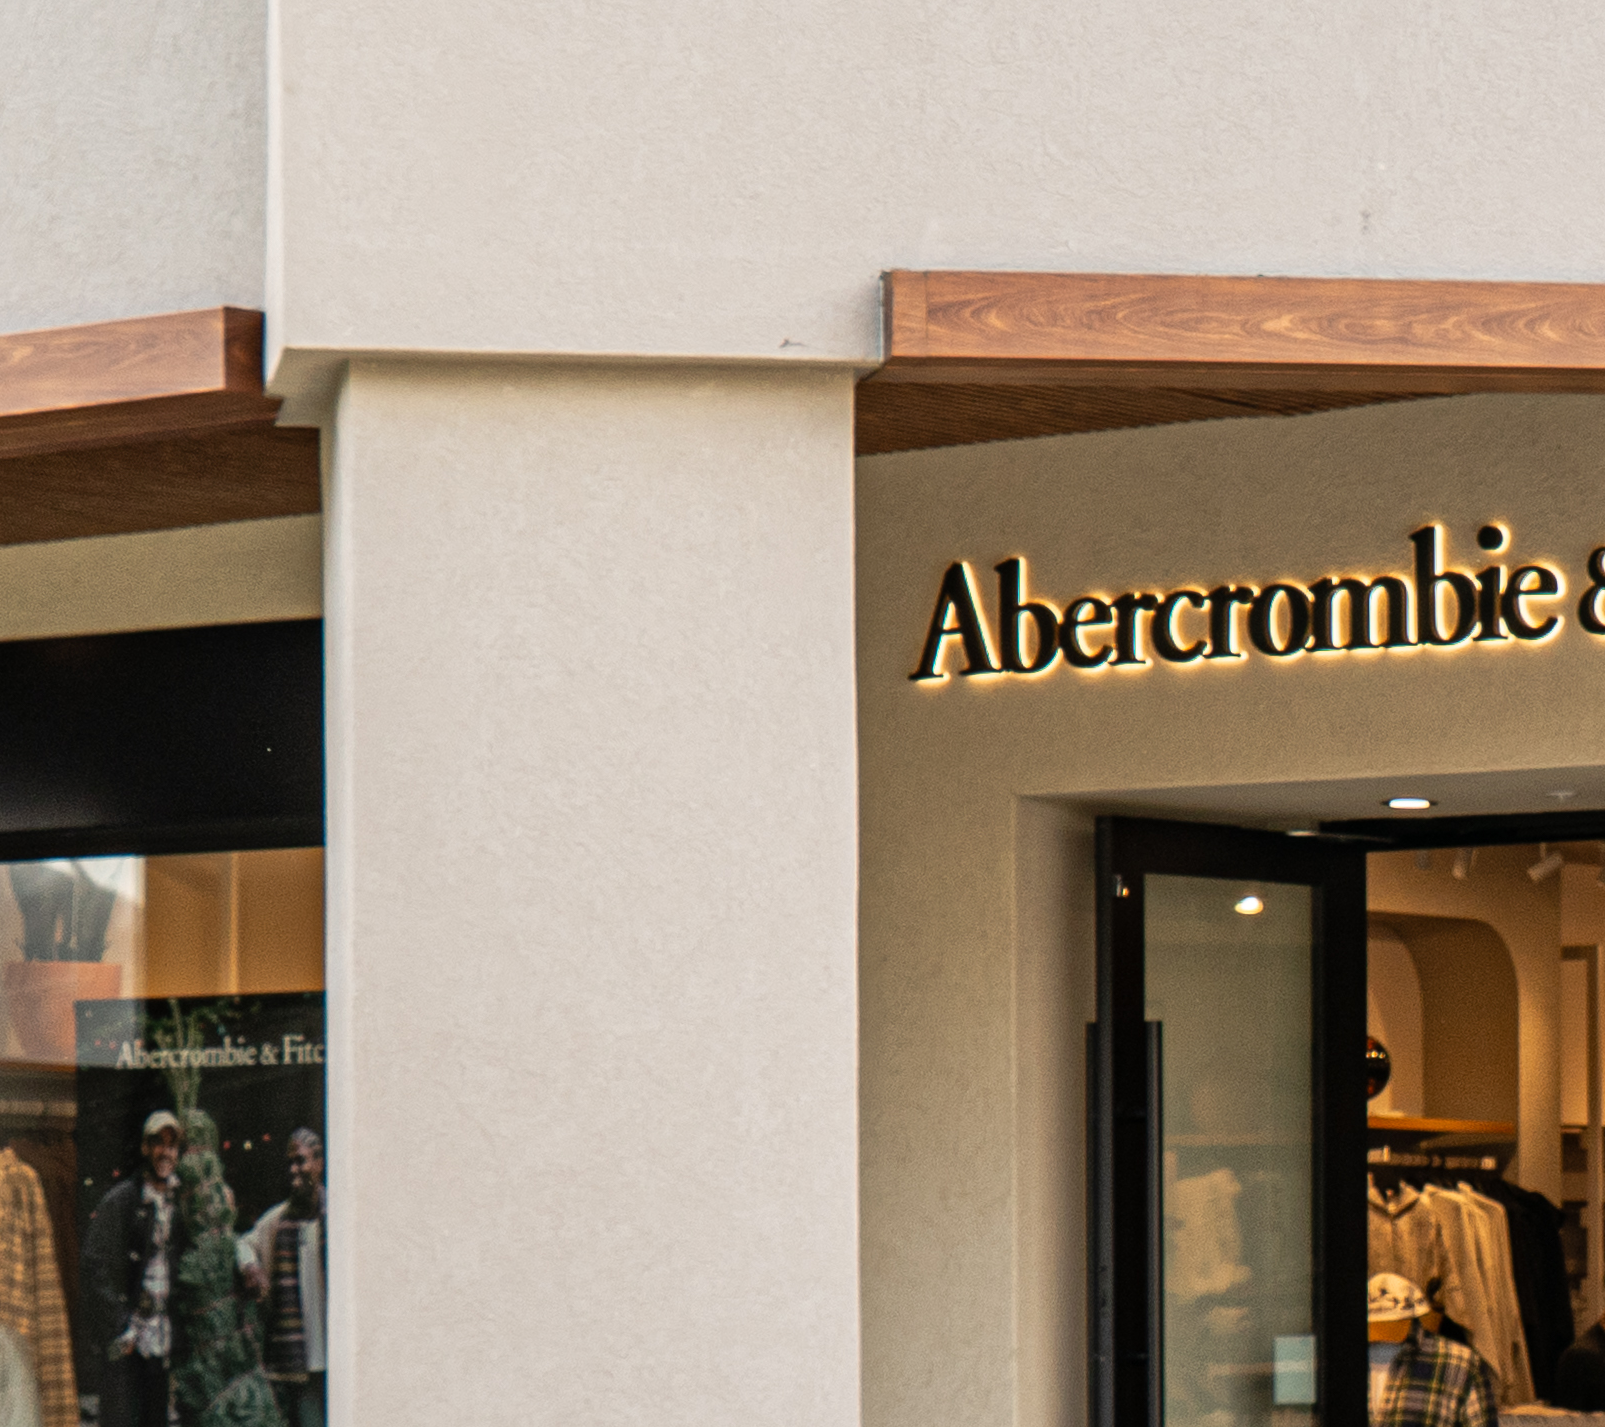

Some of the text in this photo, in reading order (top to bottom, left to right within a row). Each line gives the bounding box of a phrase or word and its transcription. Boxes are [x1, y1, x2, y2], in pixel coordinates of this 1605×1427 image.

[907, 521, 1561, 683] Abercrombie
[115, 1033, 326, 1070] Abercrombie & Fitc
